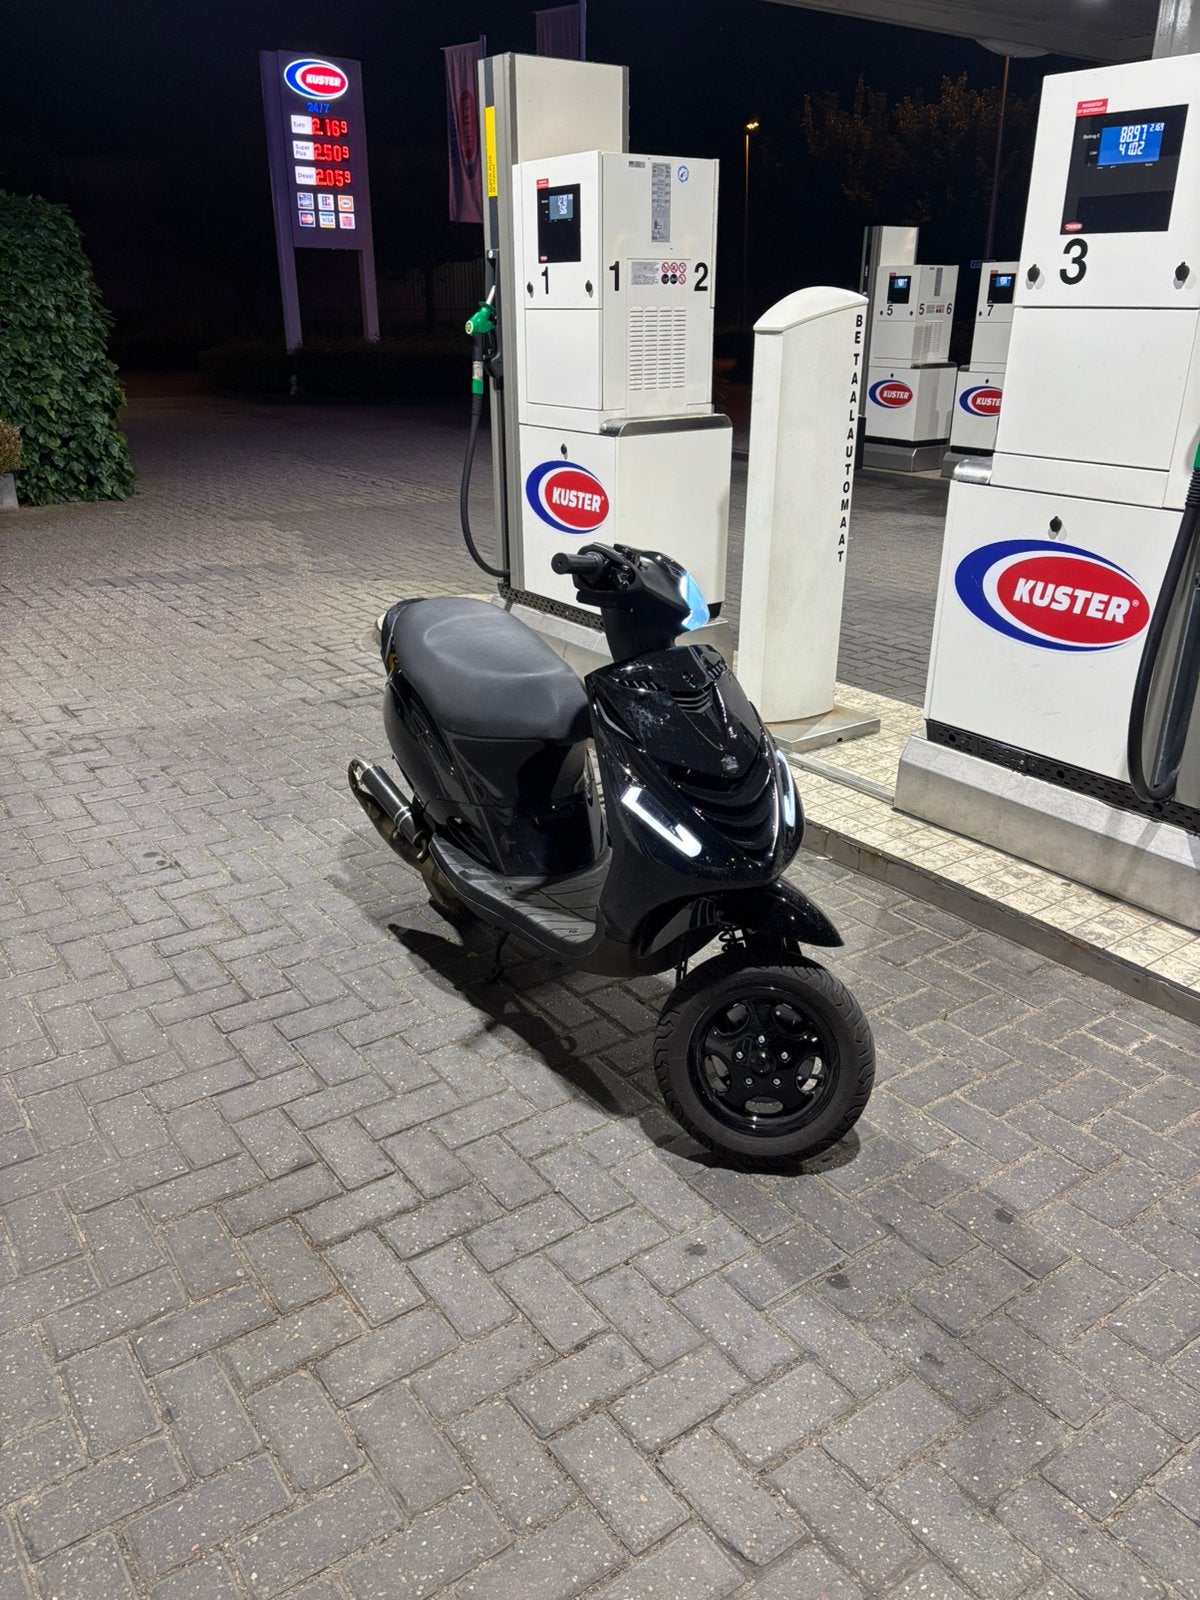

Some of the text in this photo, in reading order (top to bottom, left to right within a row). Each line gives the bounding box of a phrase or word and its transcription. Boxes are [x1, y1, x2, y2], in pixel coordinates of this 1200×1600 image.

[305, 73, 341, 87] KUSTER
[307, 102, 330, 113] 24/7
[1059, 238, 1088, 285] 3
[541, 266, 549, 294] 1
[609, 261, 620, 291] 1
[694, 262, 708, 291] 2
[887, 305, 893, 316] 5
[919, 303, 925, 315] 5
[946, 303, 952, 315] 6
[987, 304, 994, 316] 7
[882, 390, 910, 399] KUSTER
[976, 397, 1001, 406] KUSTE
[837, 314, 863, 563] BETAALAUTOMAAT
